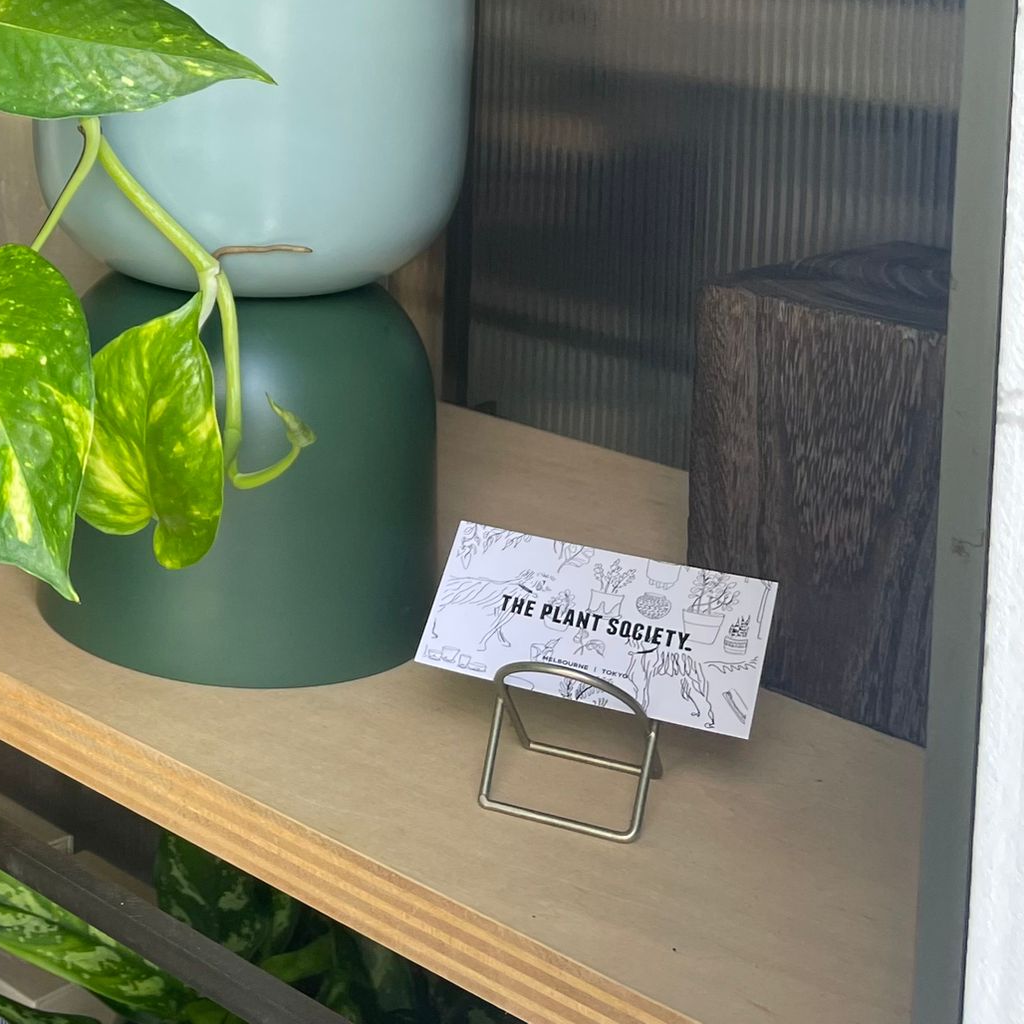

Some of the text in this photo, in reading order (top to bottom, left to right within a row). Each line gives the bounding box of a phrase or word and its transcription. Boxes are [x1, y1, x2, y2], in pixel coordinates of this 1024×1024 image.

[501, 594, 536, 617] THE
[540, 604, 602, 631] PLANT
[542, 655, 629, 679] MELBOURNE TOKYO
